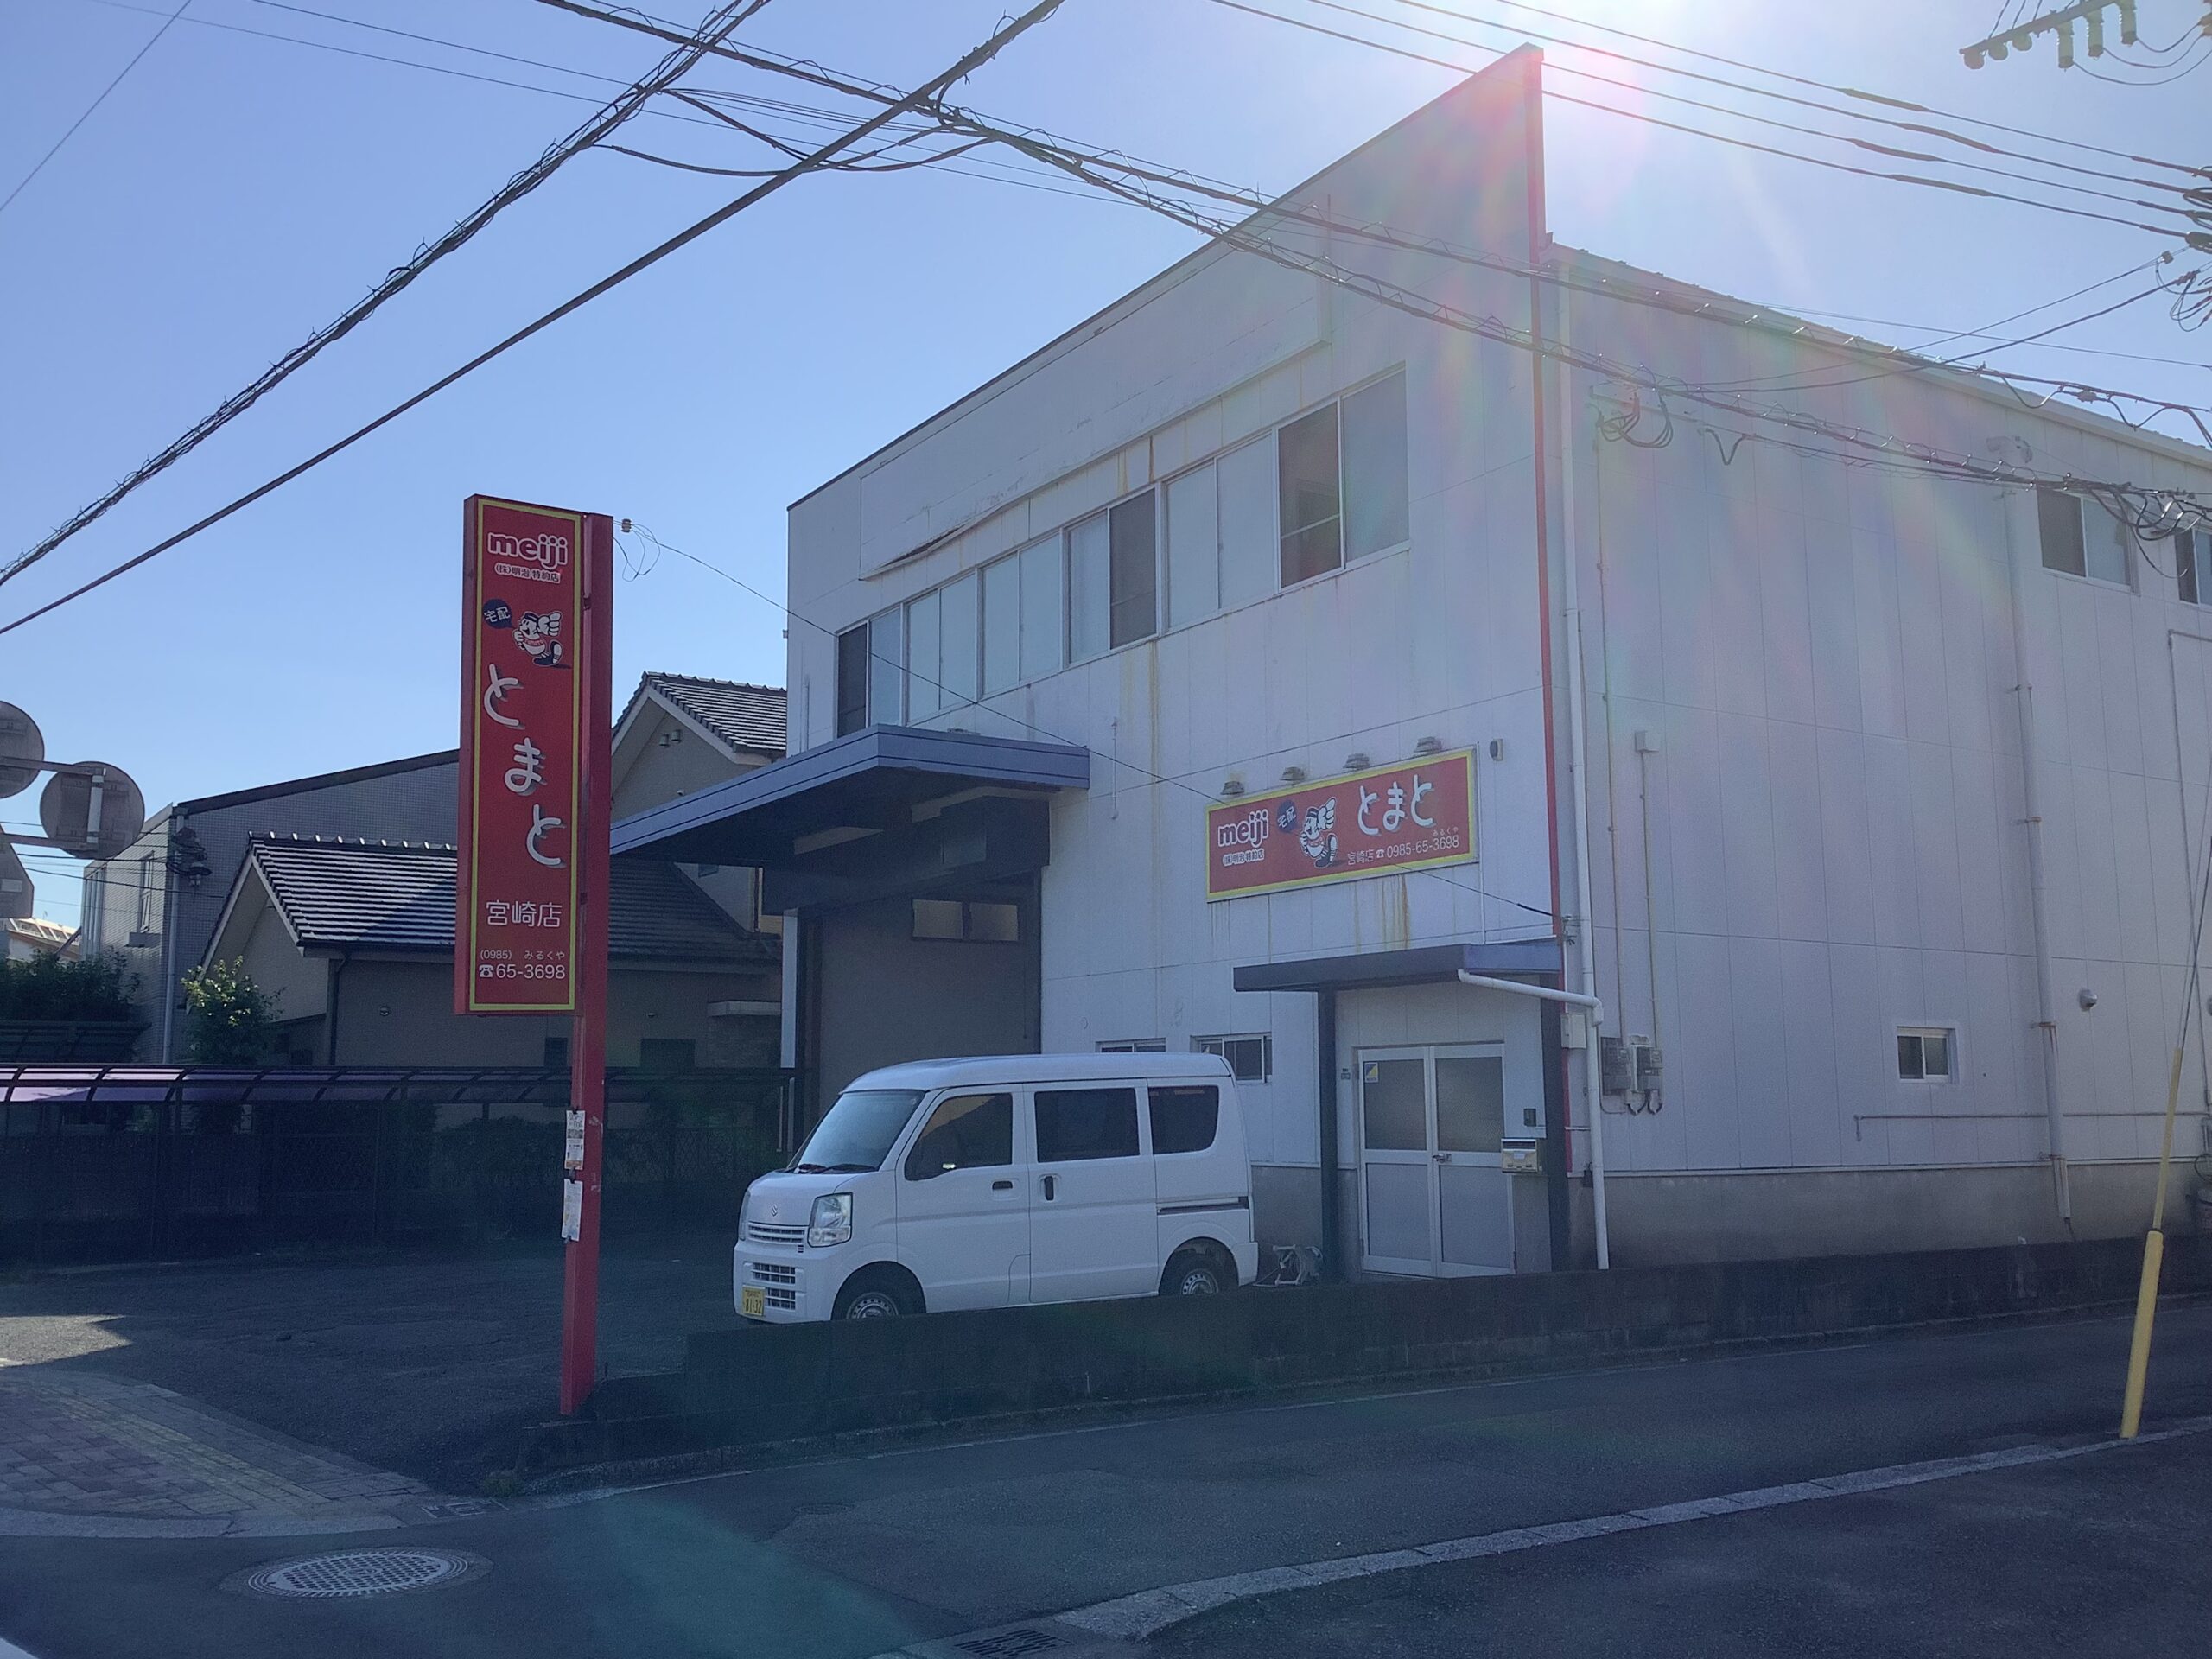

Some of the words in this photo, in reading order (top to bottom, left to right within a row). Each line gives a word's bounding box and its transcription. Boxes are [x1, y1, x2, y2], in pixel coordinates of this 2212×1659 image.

[488, 532, 568, 569] meiji
[484, 606, 511, 623] 宅配
[484, 664, 563, 866] とまと
[1357, 774, 1434, 836] とまと
[1217, 809, 1269, 848] meiji
[486, 899, 563, 927] 宮崎店
[480, 950, 512, 960] (0985)
[524, 950, 565, 960] みるくや
[496, 963, 565, 979] 65-3698
